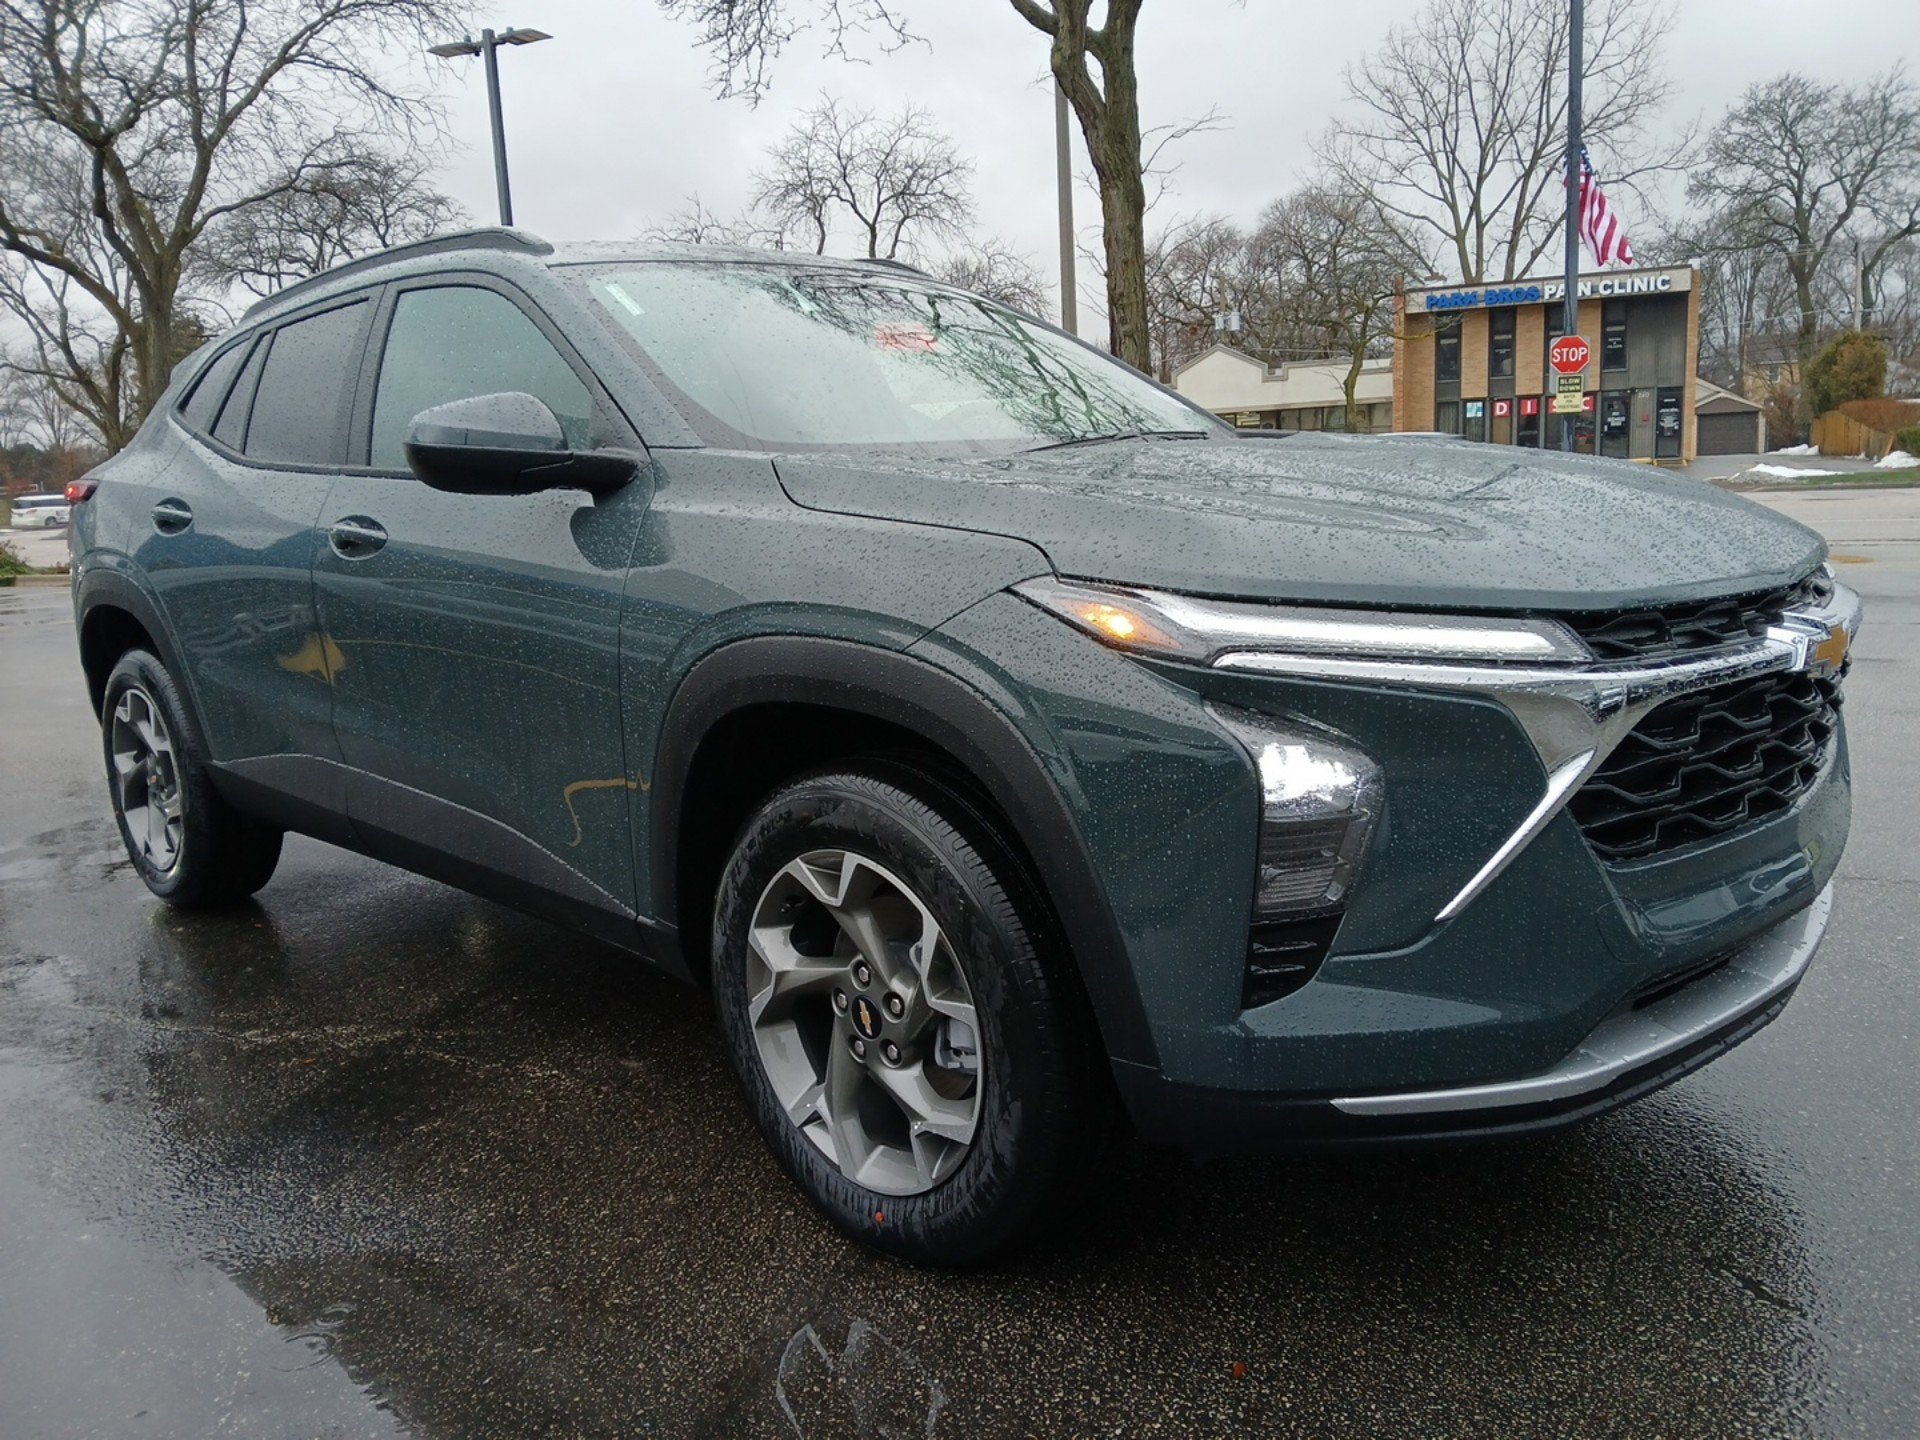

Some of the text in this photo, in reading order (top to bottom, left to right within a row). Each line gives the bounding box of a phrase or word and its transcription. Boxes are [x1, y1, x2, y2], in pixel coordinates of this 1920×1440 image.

[1426, 275, 1671, 309] PARK BROS PAN CLINIC
[1552, 347, 1588, 362] STOP
